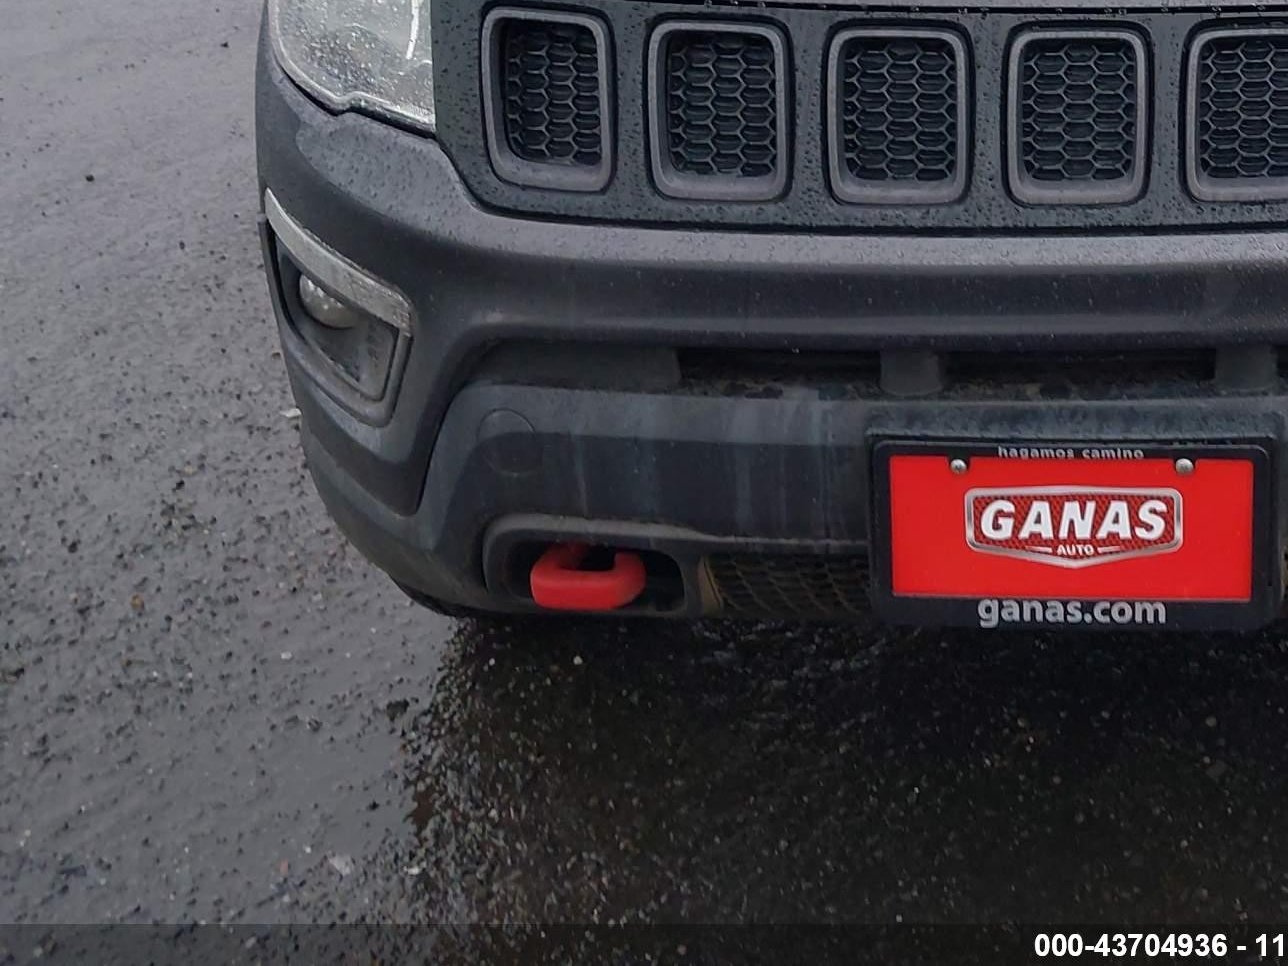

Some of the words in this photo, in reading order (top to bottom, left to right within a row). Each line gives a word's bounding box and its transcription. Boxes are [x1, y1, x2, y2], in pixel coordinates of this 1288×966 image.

[998, 445, 1075, 460] hagamos
[1082, 447, 1144, 459] camino
[980, 499, 1168, 541] GANAS
[1056, 544, 1095, 556] AUTO
[977, 598, 1167, 629] ganas.com
